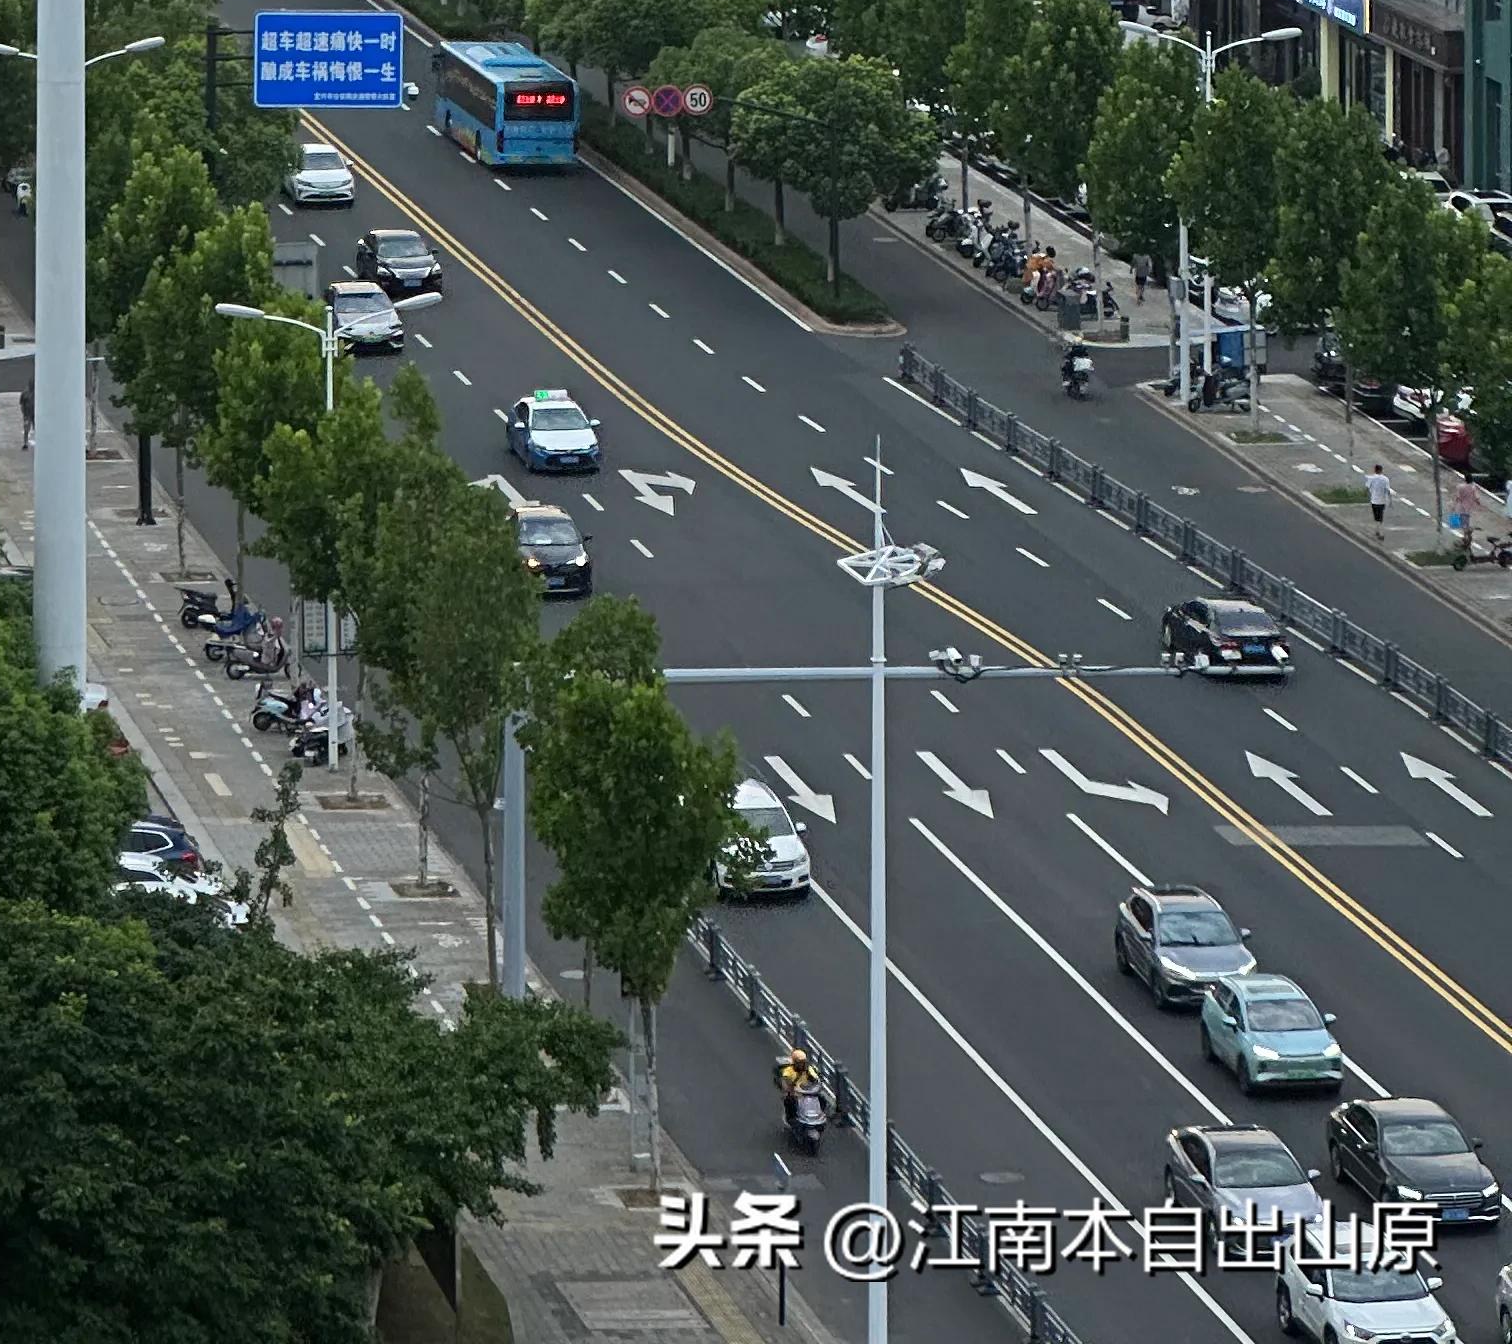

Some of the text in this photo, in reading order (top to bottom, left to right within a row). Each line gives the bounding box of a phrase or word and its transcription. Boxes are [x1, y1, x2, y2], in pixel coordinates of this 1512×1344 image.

[261, 30, 397, 52] 超车超速痛快一时
[261, 60, 397, 82] 酿成车祸悔恨一生
[690, 92, 707, 107] 50
